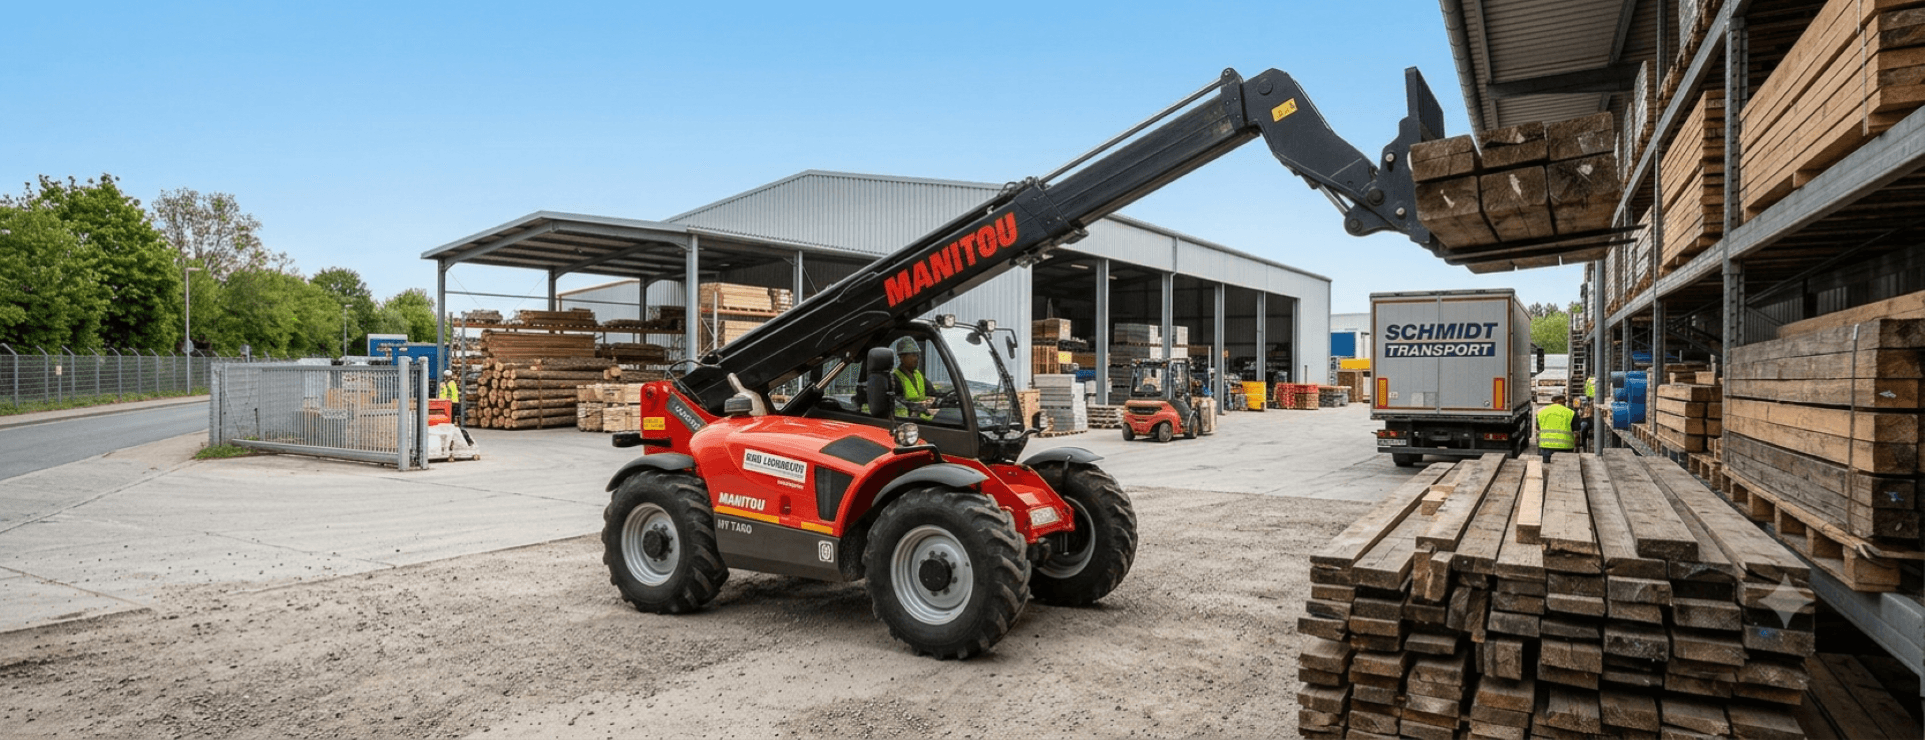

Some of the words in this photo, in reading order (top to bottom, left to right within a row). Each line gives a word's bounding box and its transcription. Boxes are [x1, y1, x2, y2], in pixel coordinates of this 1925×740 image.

[883, 211, 1018, 308] MANITOU
[1385, 322, 1499, 341] SCHMIDT
[1387, 343, 1493, 357] TRANSPORT
[718, 491, 766, 511] MANITOU
